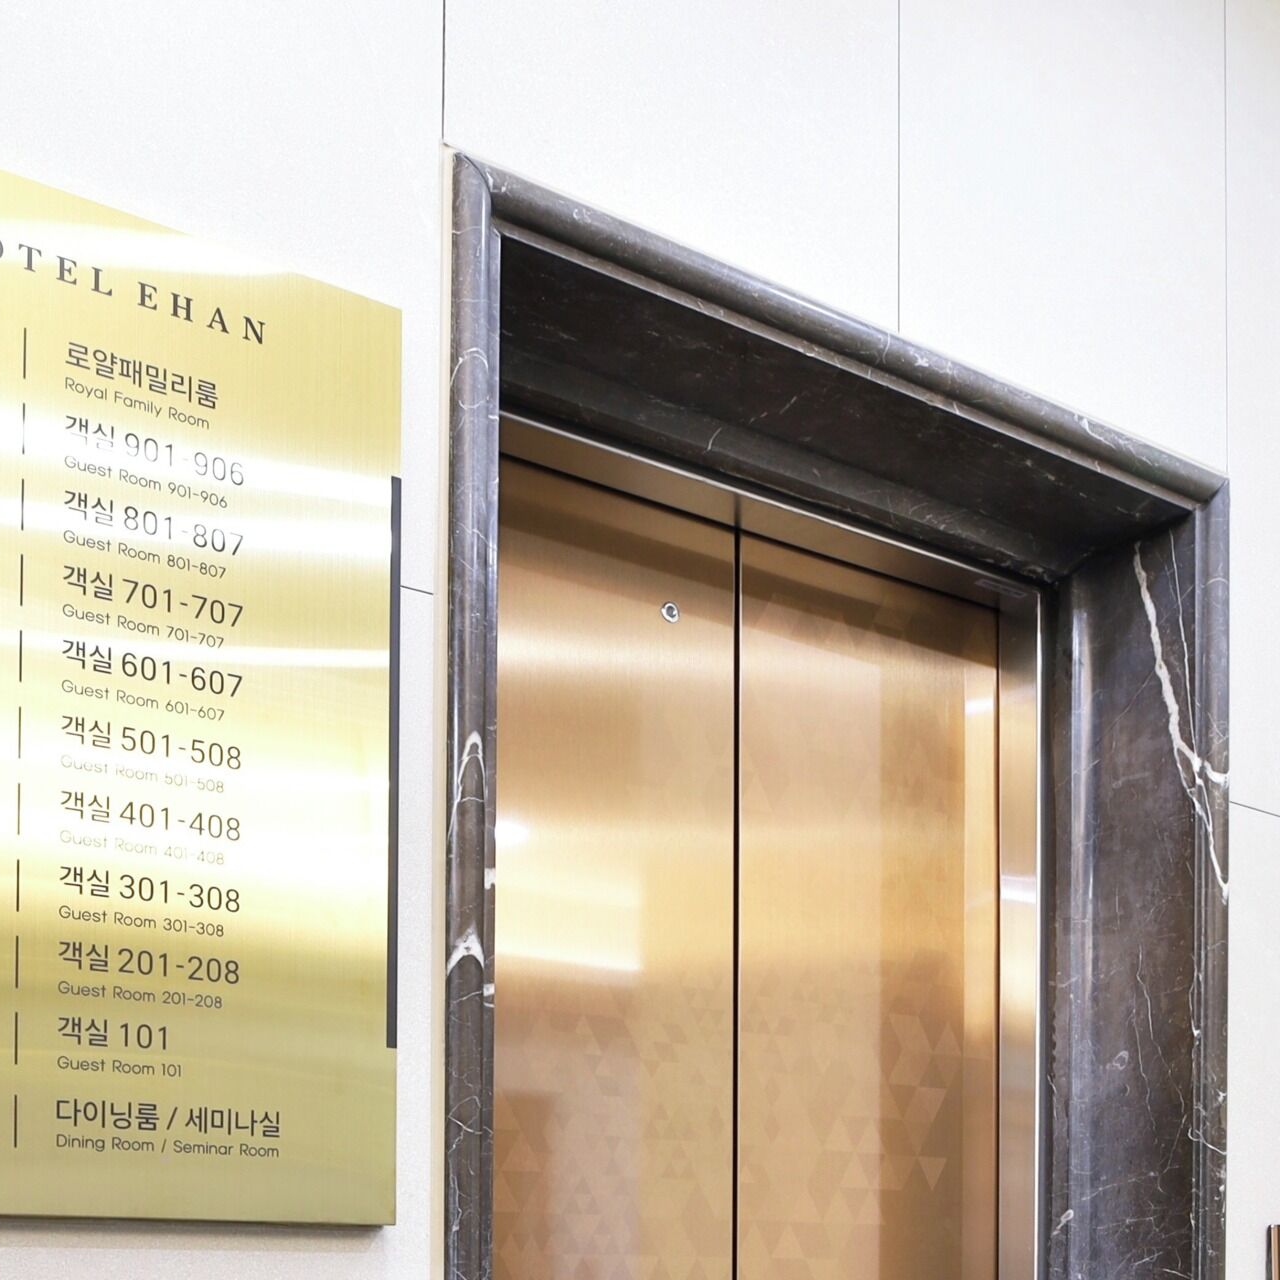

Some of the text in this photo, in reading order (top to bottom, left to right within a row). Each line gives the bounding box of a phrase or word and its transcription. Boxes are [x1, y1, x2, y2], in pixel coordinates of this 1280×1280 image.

[137, 281, 265, 345] EHAN
[65, 342, 218, 409] 로얄패밀리룸
[65, 377, 209, 429] Royal Family Room
[65, 415, 244, 486] 객실 901-906
[64, 456, 228, 509] Guest Room 901-906
[64, 490, 244, 556] 객실 801-807
[63, 530, 226, 579] Guest Room 801-807
[63, 565, 243, 627] 객실 701-707
[62, 604, 224, 649] Guest Room 701-707
[62, 640, 243, 698] 객실 601-607
[61, 679, 225, 721] Guest Room 601-607
[61, 715, 241, 770] 객실 501-508
[60, 754, 224, 793] Guest Room 501-508
[60, 790, 240, 841] 객실 401-408
[59, 829, 224, 865] Guest Room 401-408
[59, 866, 240, 912] 객실 301-308
[58, 905, 224, 937] Guest Room 301-308
[58, 941, 239, 984] 객실 201-208
[58, 980, 222, 1009] Guest Room 201-208
[58, 1017, 168, 1050] 객실 101
[57, 1056, 182, 1077] Guest Room 101
[56, 1098, 280, 1138] 다이닝룸 / 세미나실
[56, 1134, 280, 1158] Dining Room / Seminar Room
